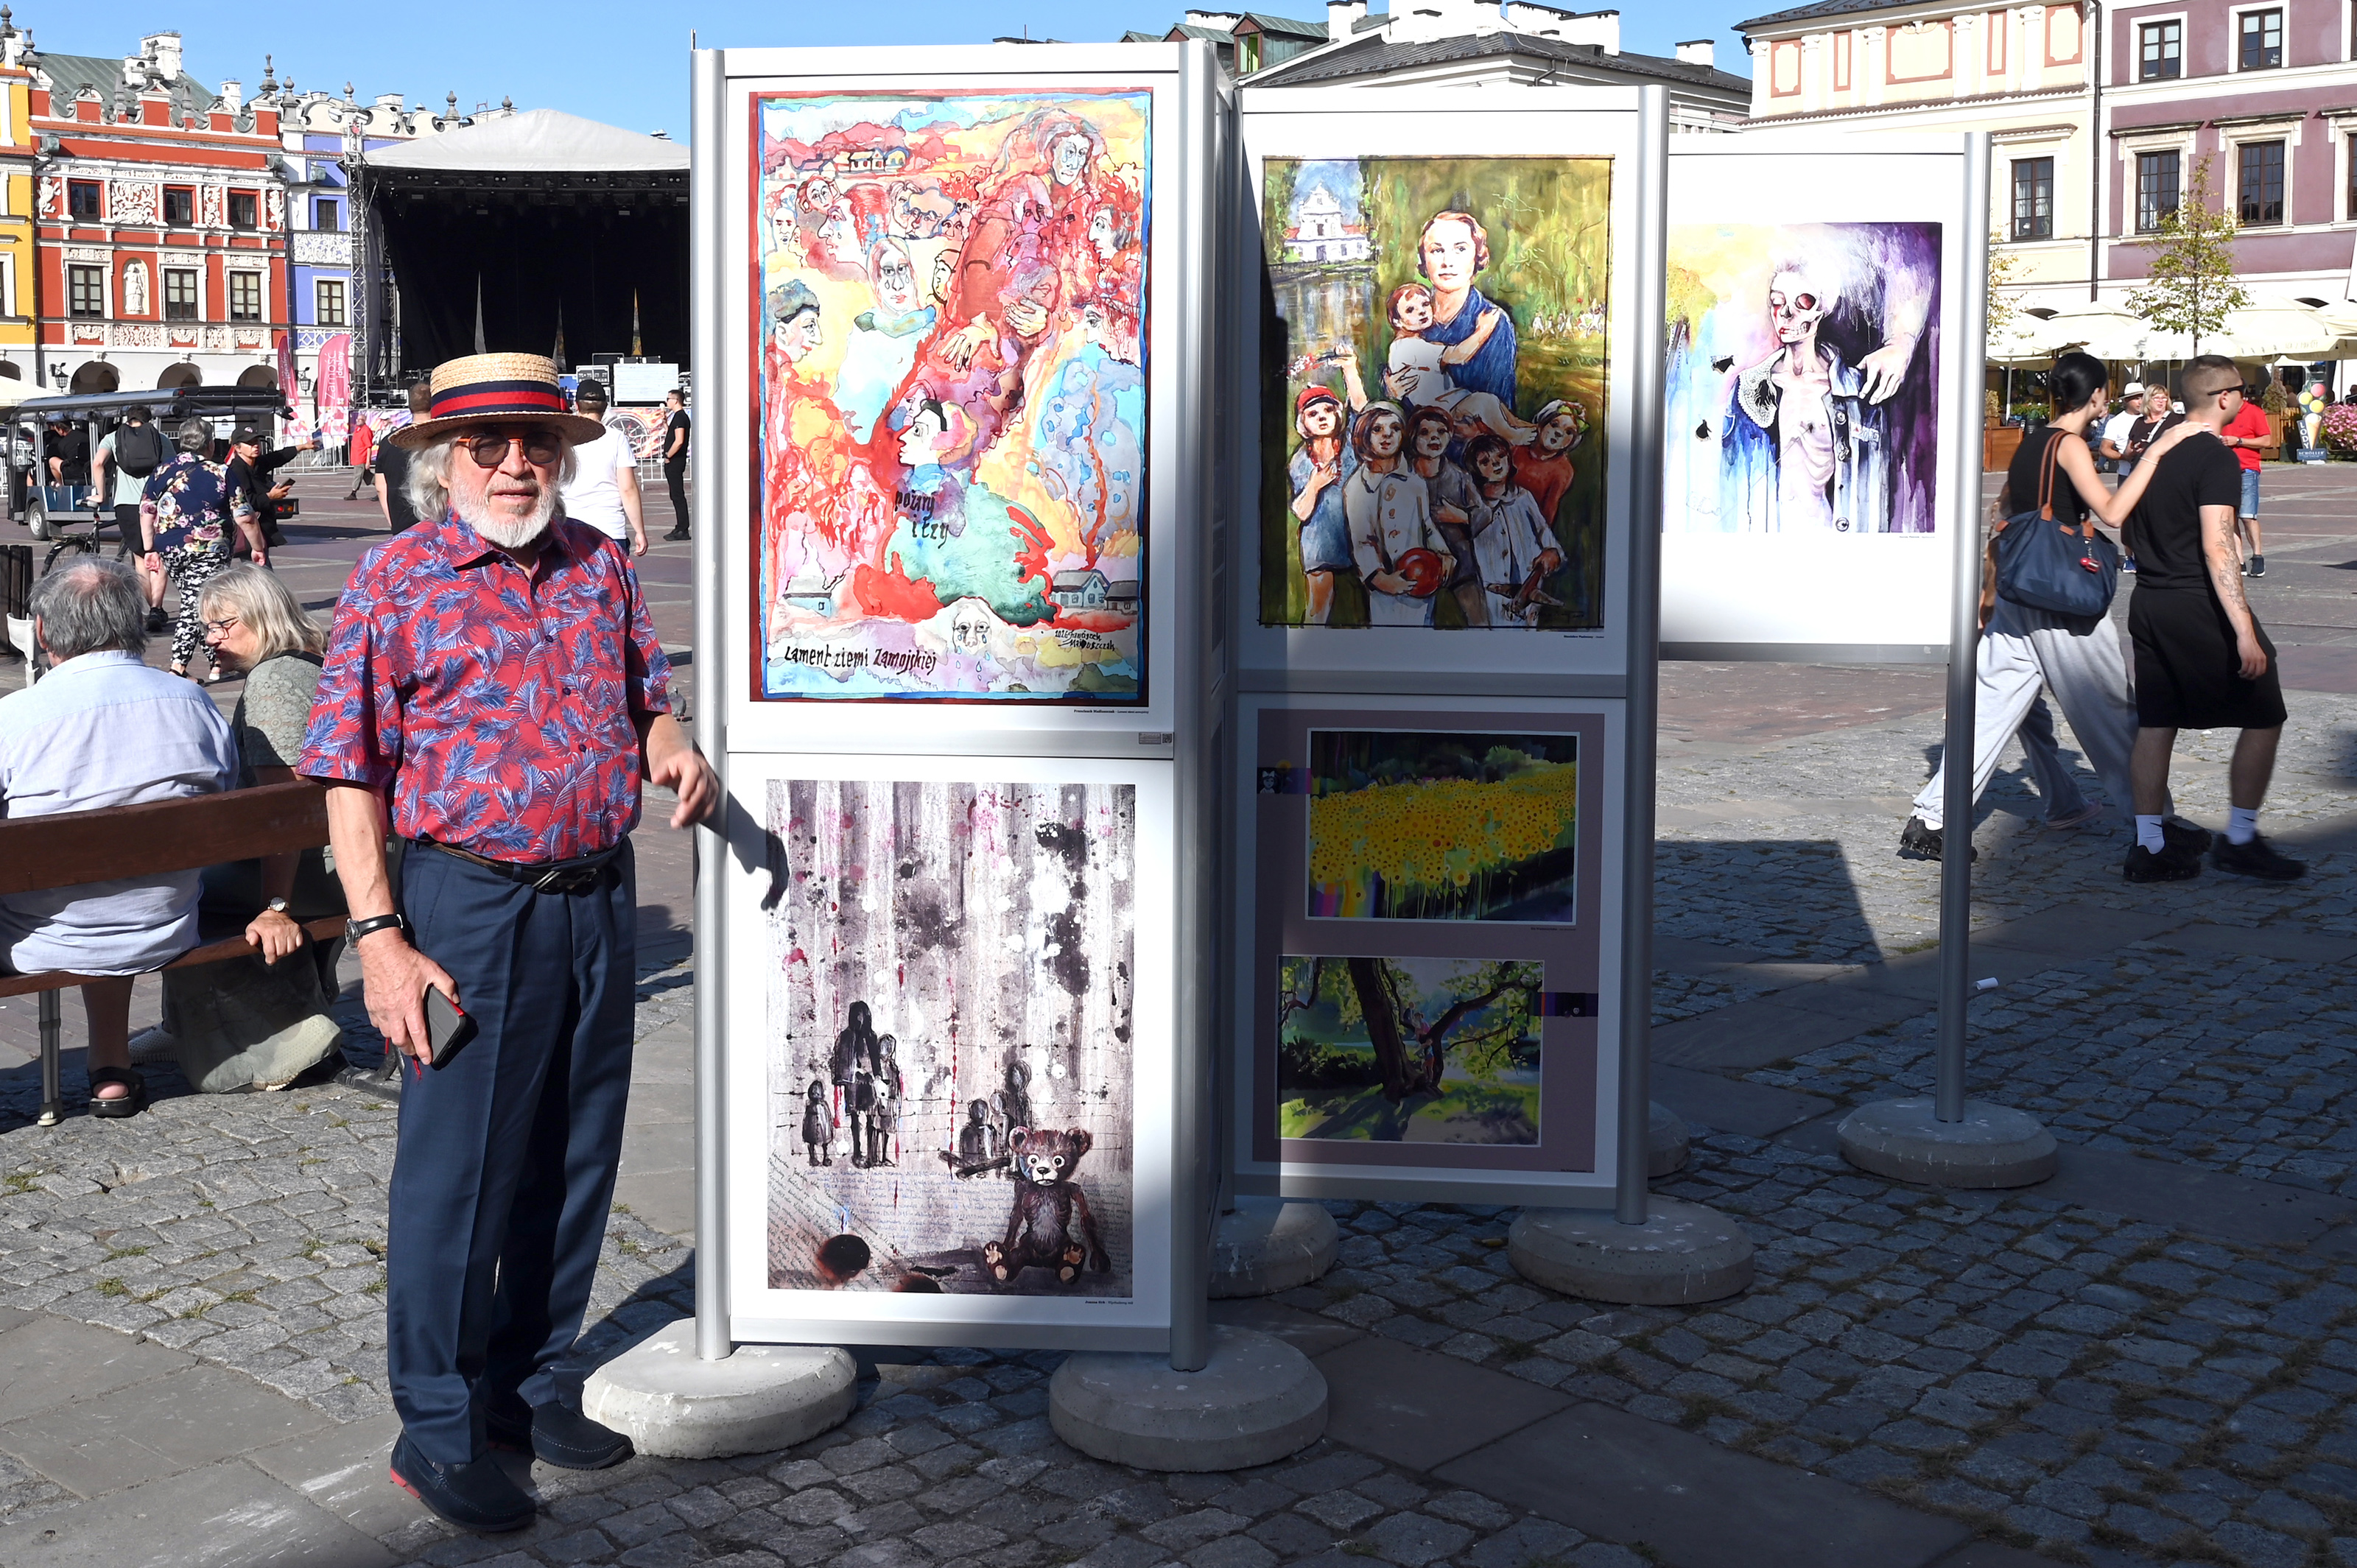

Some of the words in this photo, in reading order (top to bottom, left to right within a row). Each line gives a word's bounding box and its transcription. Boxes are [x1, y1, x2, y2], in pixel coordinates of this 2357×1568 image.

[325, 351, 336, 399] Zamość
[336, 351, 345, 379] idealny
[2300, 422, 2309, 449] LODY
[913, 514, 918, 538] i
[784, 644, 832, 667] Lament
[834, 647, 868, 667] ziemi
